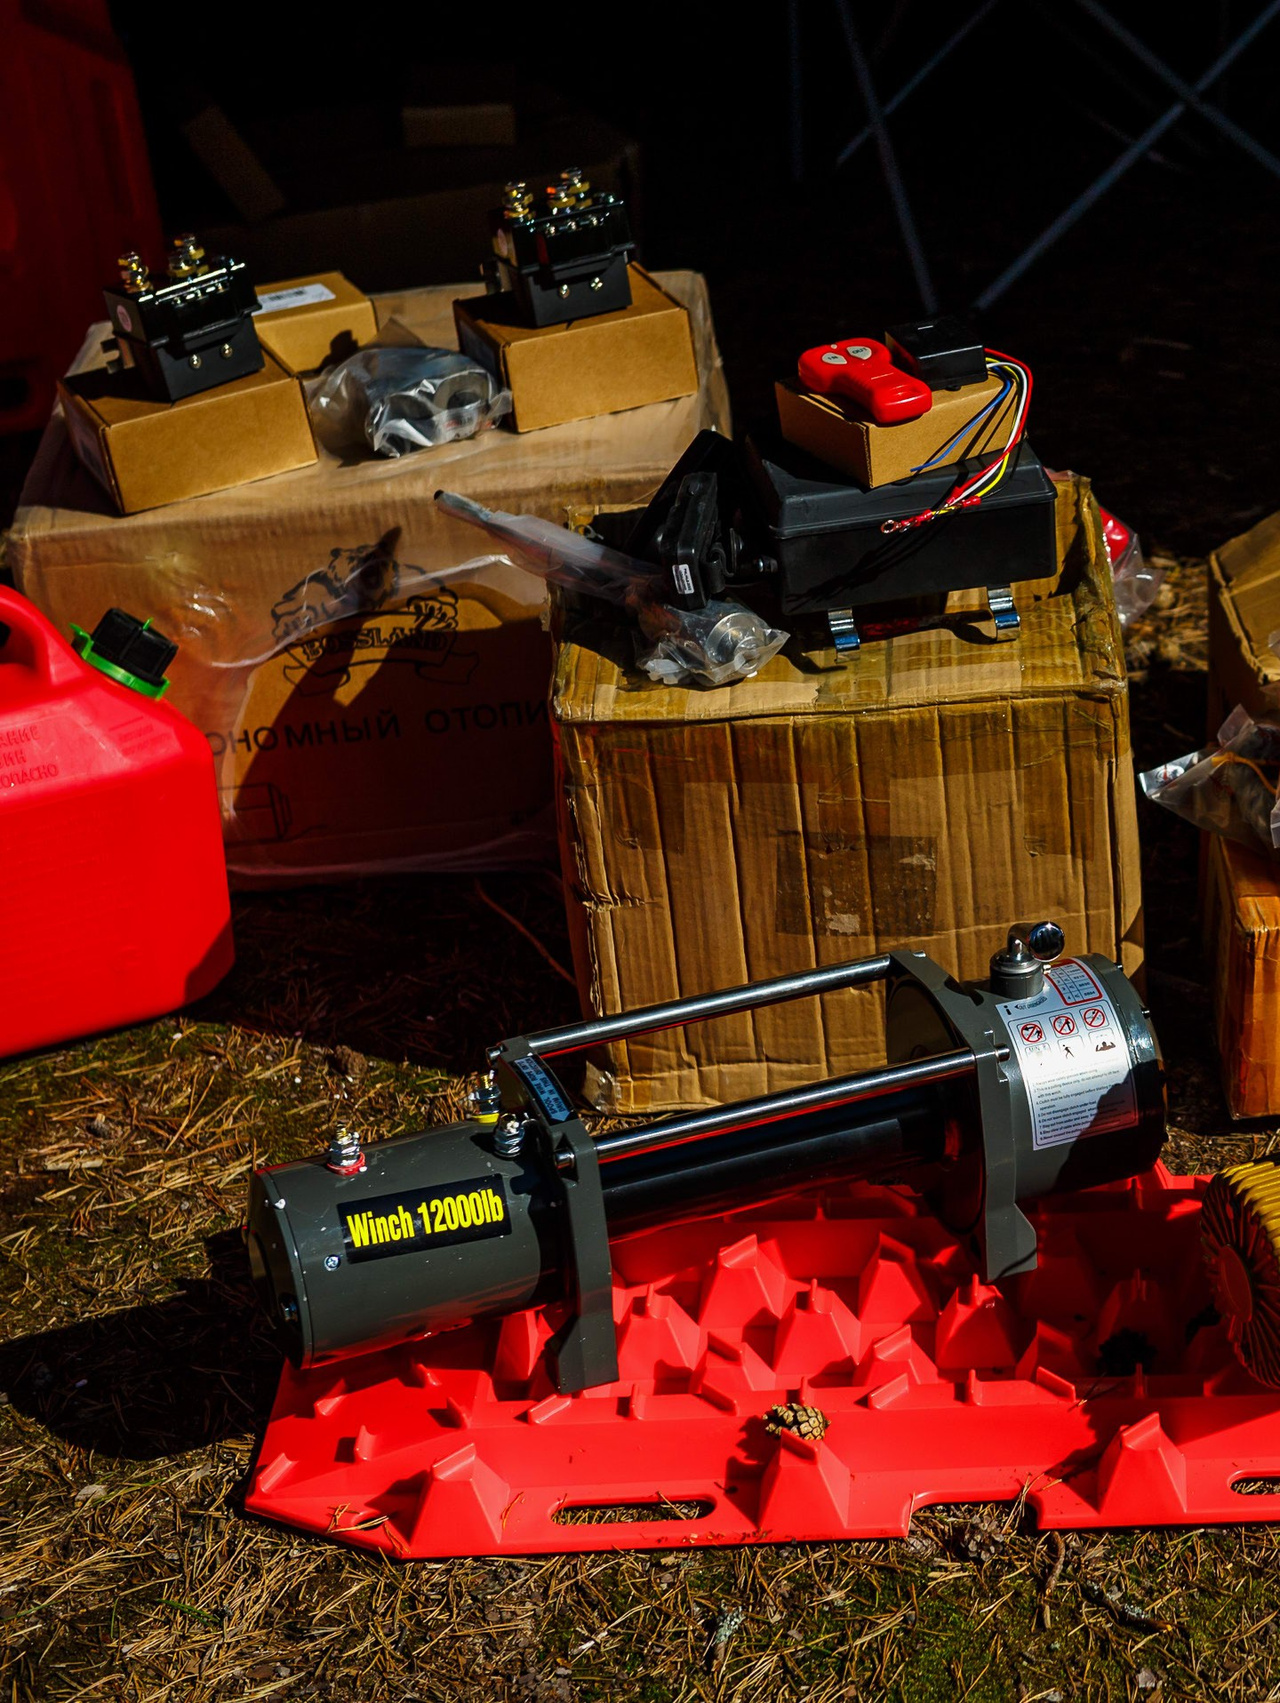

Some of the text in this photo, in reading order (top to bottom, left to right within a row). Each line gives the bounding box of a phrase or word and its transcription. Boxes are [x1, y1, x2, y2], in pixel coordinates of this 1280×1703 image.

[852, 346, 867, 354] OUT
[304, 627, 449, 661] BOSSLAND
[0, 763, 59, 788] ОПАСНО
[346, 1188, 504, 1248] Winch 12000lb
